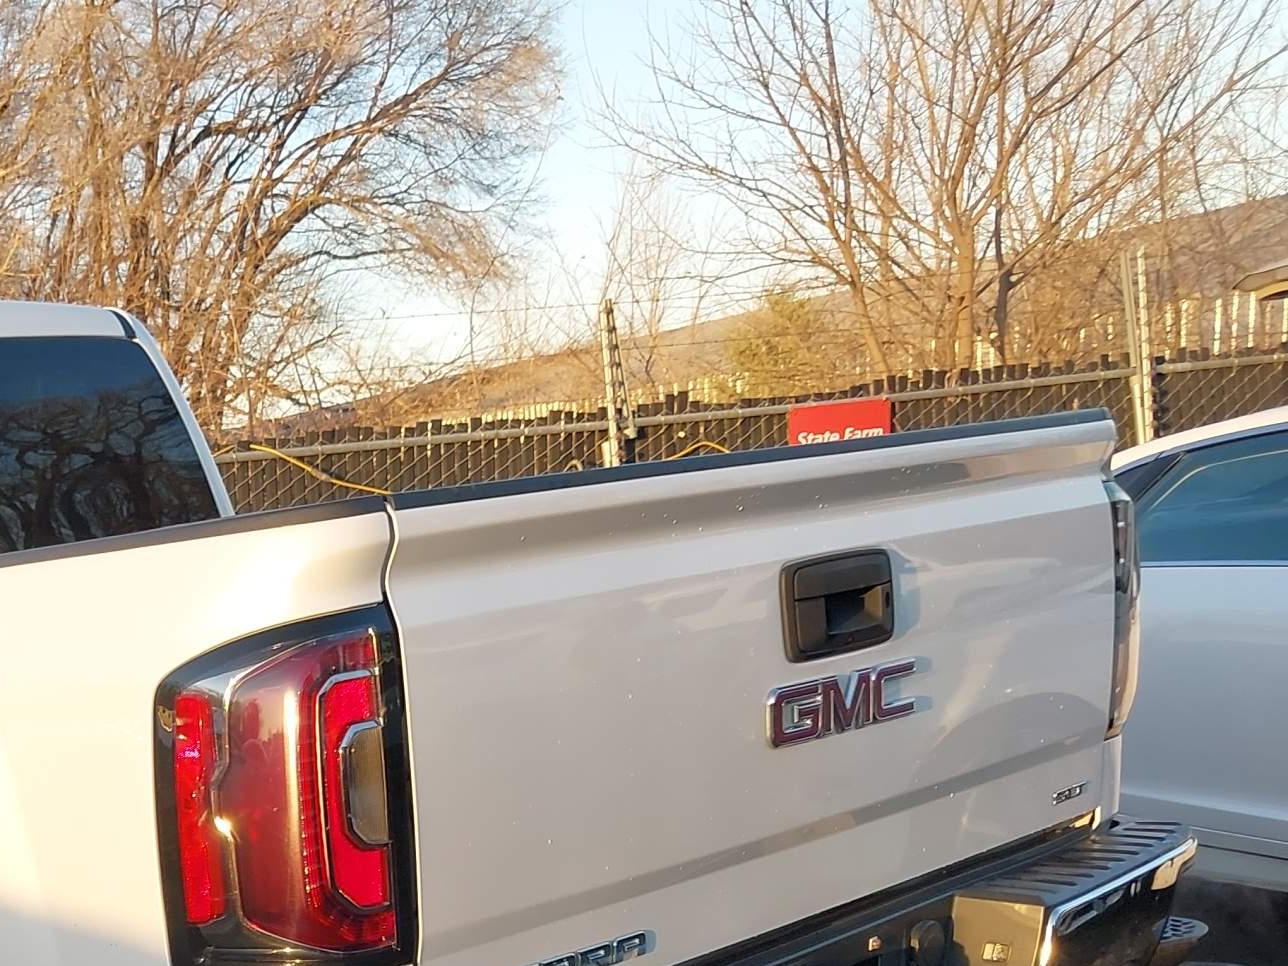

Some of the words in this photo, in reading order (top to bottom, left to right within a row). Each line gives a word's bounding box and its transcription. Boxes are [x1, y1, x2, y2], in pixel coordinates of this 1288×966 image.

[797, 430, 840, 445] State
[843, 427, 884, 441] Farm
[765, 657, 917, 749] GMC
